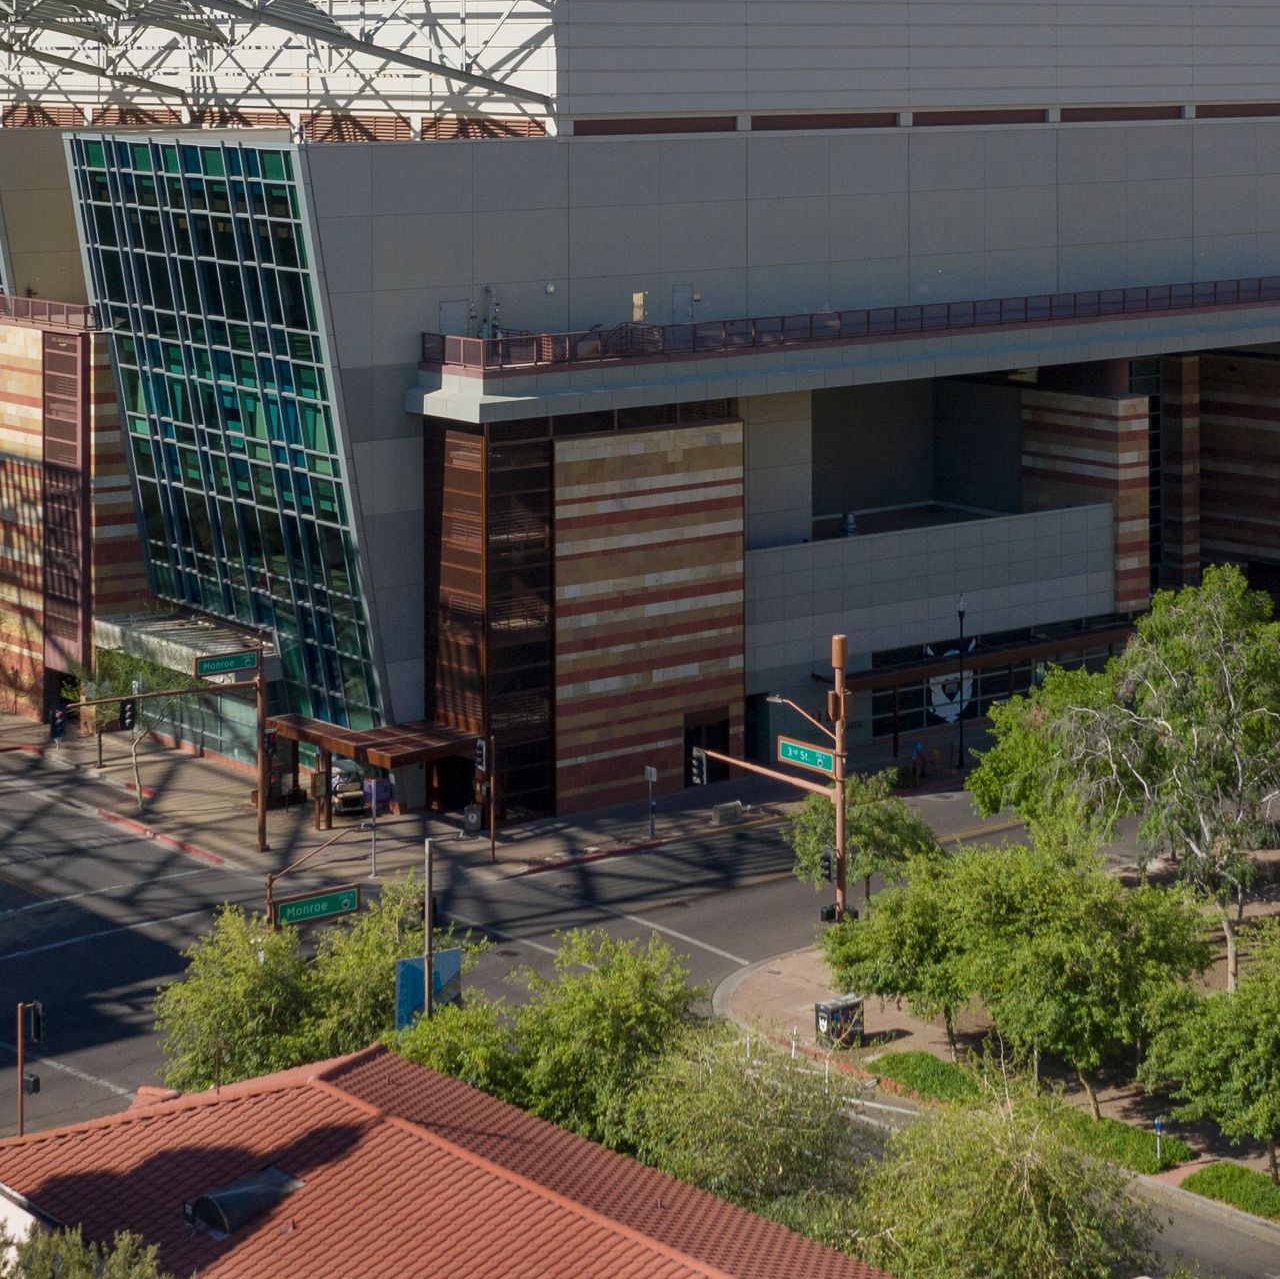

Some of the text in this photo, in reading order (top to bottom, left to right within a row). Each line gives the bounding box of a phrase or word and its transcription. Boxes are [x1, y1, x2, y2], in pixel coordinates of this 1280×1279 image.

[203, 659, 235, 672] Monroe
[787, 746, 799, 757] 3rd
[286, 901, 329, 919] Monroe
